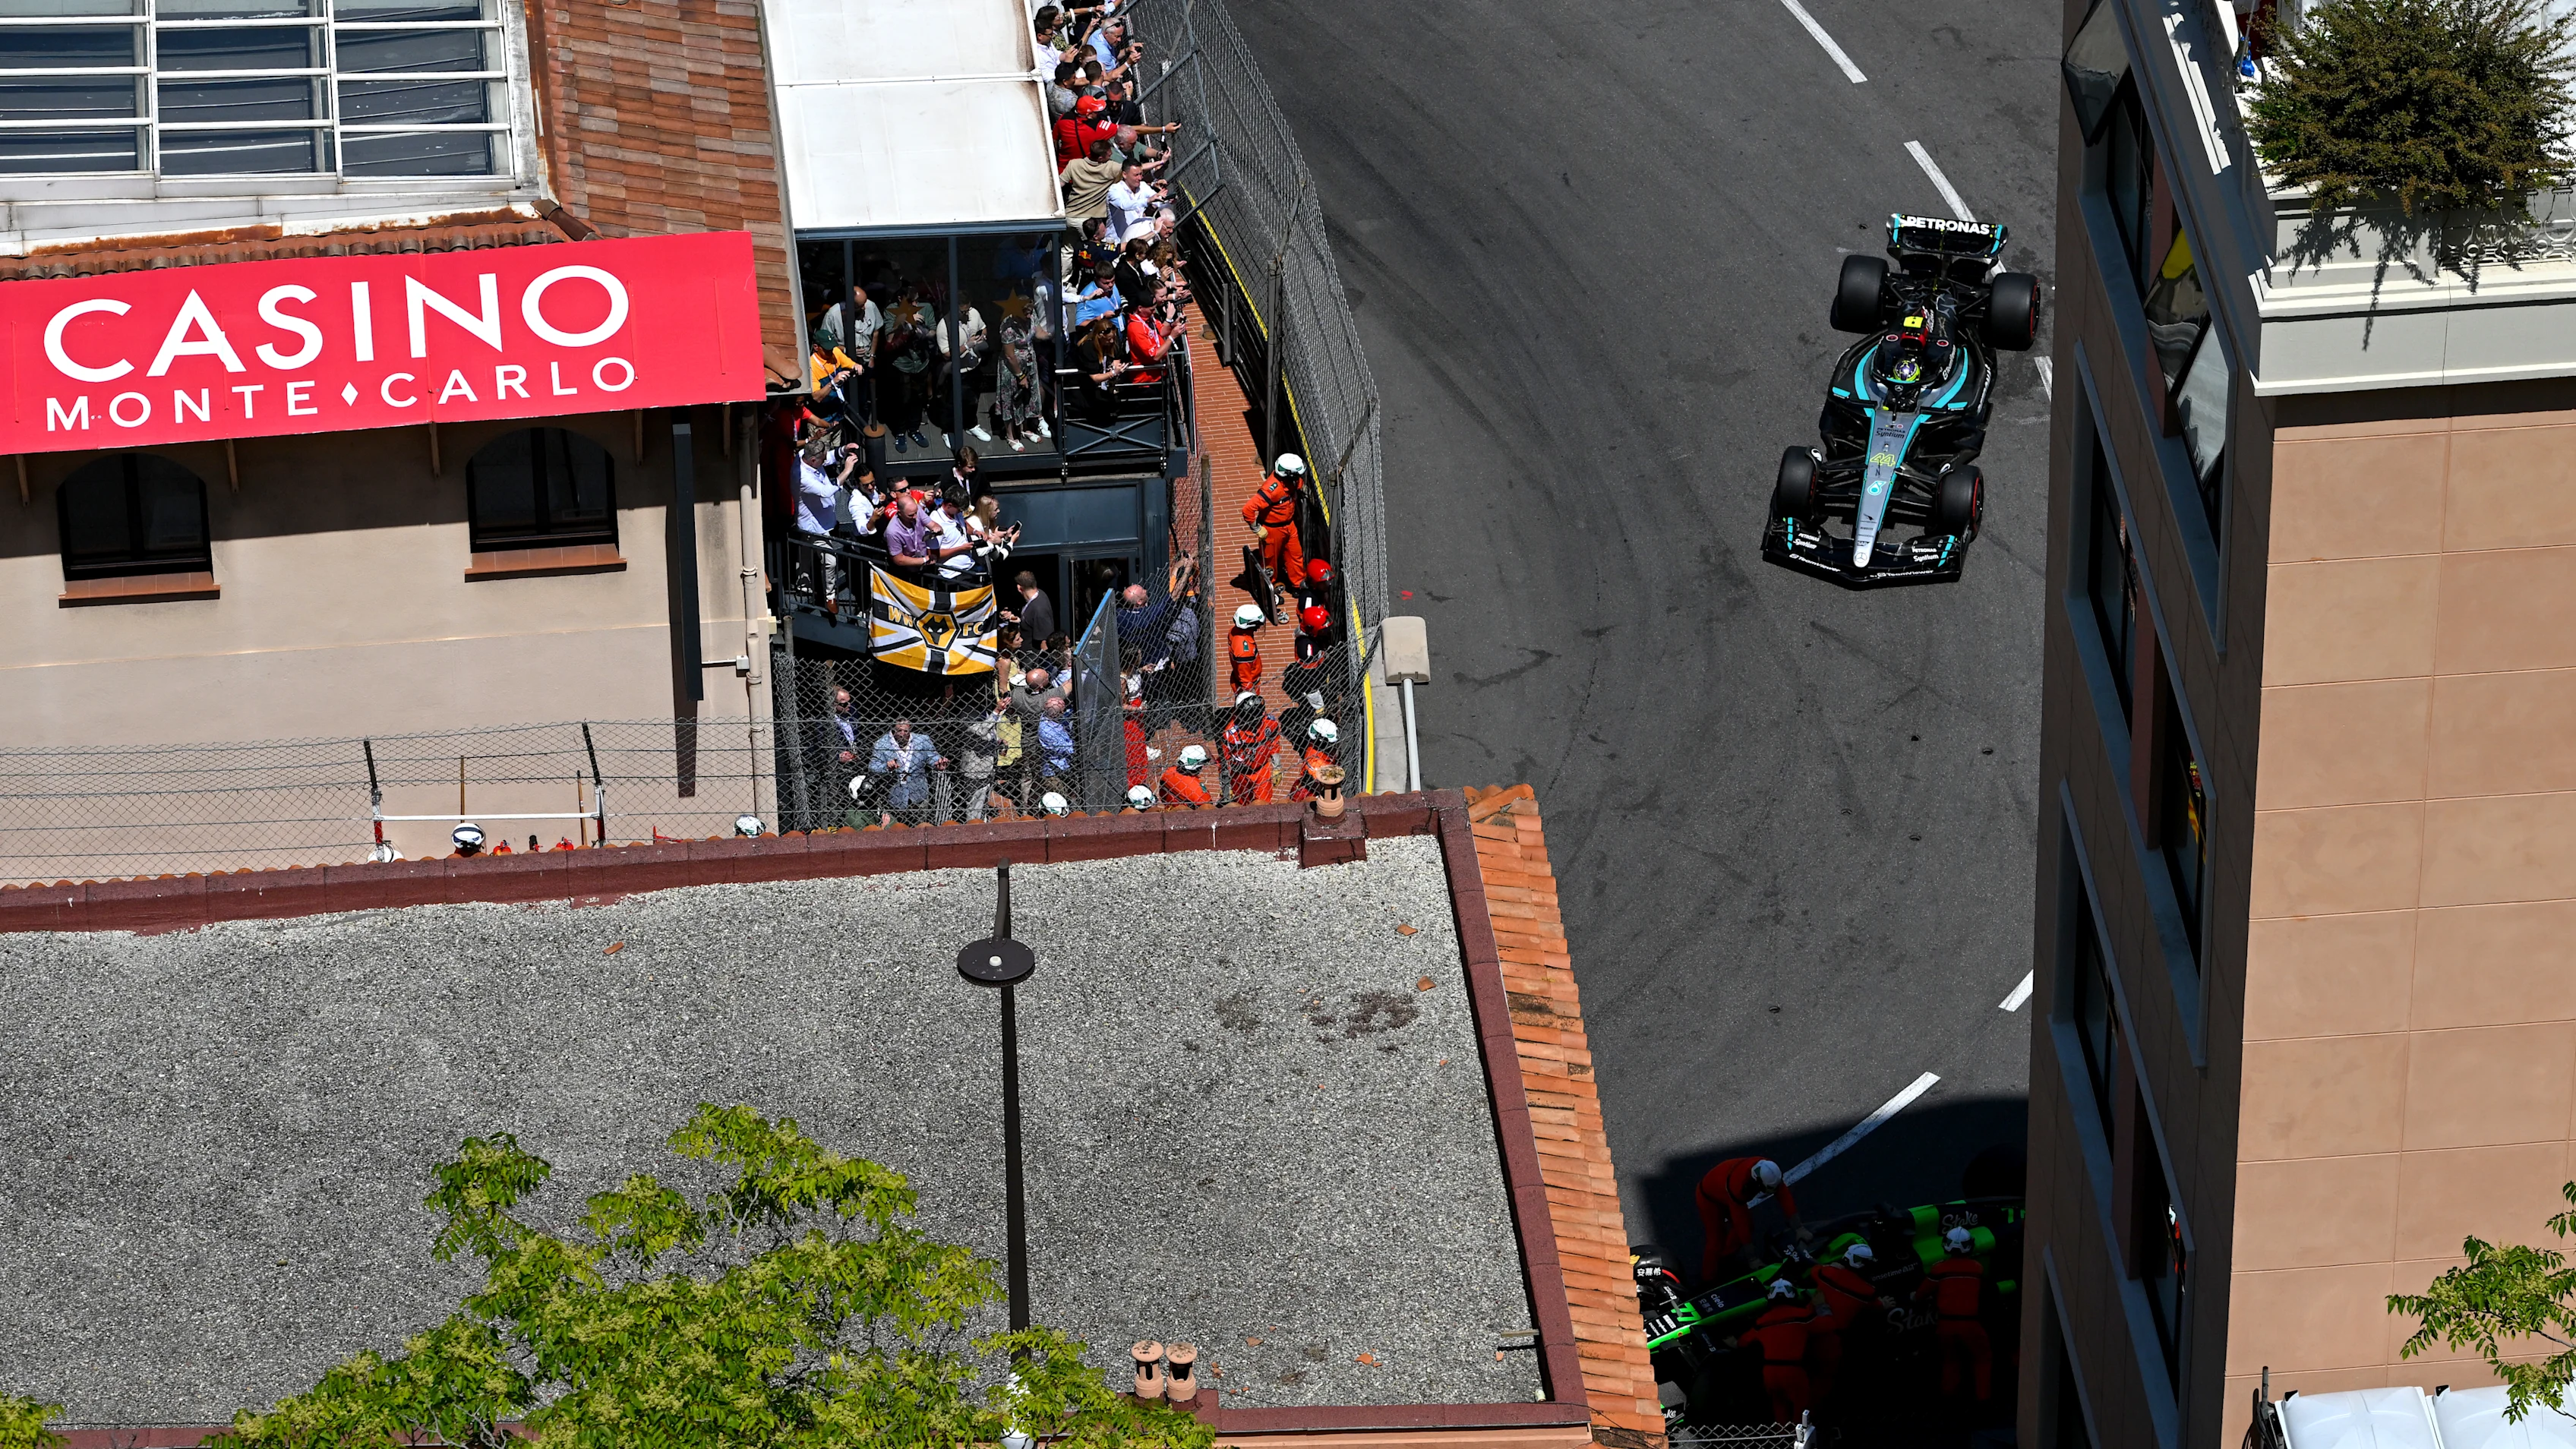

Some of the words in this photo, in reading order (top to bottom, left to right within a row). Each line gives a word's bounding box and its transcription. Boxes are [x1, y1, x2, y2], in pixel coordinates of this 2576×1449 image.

[1905, 216, 1990, 235] PETRONAS
[43, 264, 630, 383] CASINO
[46, 380, 318, 432] MONTE
[380, 357, 637, 409] CARLO
[1875, 430, 1905, 439] Syntium
[1870, 453, 1896, 467] 44
[1793, 538, 1817, 550] Syntium
[1798, 532, 1820, 542] PETRONAS
[1798, 555, 1841, 573] TeamViewer
[1913, 554, 1940, 562] Syntium
[1941, 1210, 1979, 1236] Stake
[1710, 1293, 1725, 1309] cielo
[1670, 1302, 1702, 1323] 77
[1886, 1302, 1939, 1334] Stak
